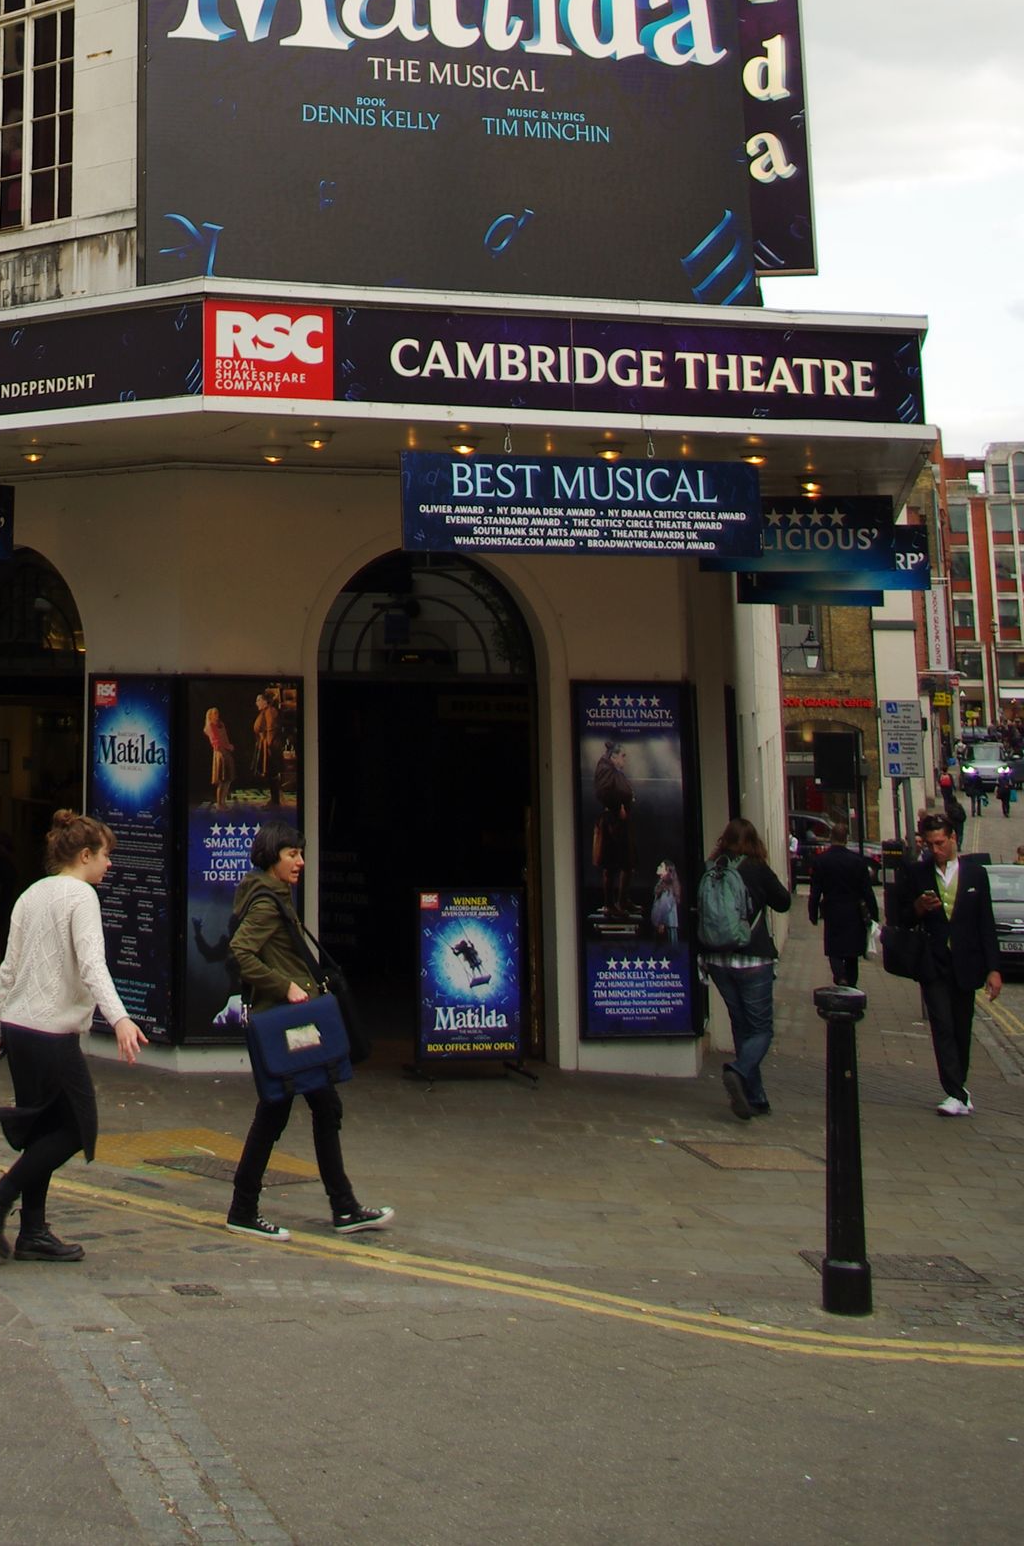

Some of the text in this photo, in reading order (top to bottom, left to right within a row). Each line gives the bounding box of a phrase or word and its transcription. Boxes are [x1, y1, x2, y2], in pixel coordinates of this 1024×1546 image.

[367, 57, 545, 93] THE MUSICAL
[356, 96, 386, 107] BOOK
[301, 104, 440, 131] DENNIS KELLY
[507, 107, 585, 122] MUSIC & LYRICS
[482, 117, 611, 142] TIM MINCHIN
[216, 310, 324, 364] RSC
[215, 359, 256, 370] ROYAL
[390, 338, 877, 397] CAMBRIDGE THEATRE
[215, 369, 307, 384] SHAKESPEARE
[215, 380, 281, 392] COMPANY
[452, 462, 718, 503] BEST MUSICAL
[419, 504, 747, 521] OLIVIER AWARD NY DRAMA DESK AWARD NY DRAMA CRITICS' CIRCLE AWARD
[445, 515, 723, 531] EVENING STANDARD AWARD THE CRITICS' CIRCLE THEATRE AWARD
[473, 526, 699, 540] SOUTH BANK SKY ARTS AWARD THEATRE AWARDS UK
[761, 528, 879, 551] LICIOUS'
[453, 536, 717, 550] WHATSONSTAGE.COM AWARD BROADWAYWORLD.COM AWARD
[640, 709, 673, 719] NASTY.
[97, 734, 167, 765] Matilda
[216, 859, 247, 869] CAN'T
[202, 870, 218, 882] TO
[219, 871, 236, 882] SEE
[421, 894, 438, 903] RSC
[452, 896, 488, 906] WINNER
[627, 971, 655, 980] KELLY'S
[592, 990, 608, 998] TIM
[608, 990, 647, 998] MINCHIN'S
[433, 1004, 509, 1031] Matilda
[427, 1042, 515, 1052] BOX OFFICE NOW OPEN
